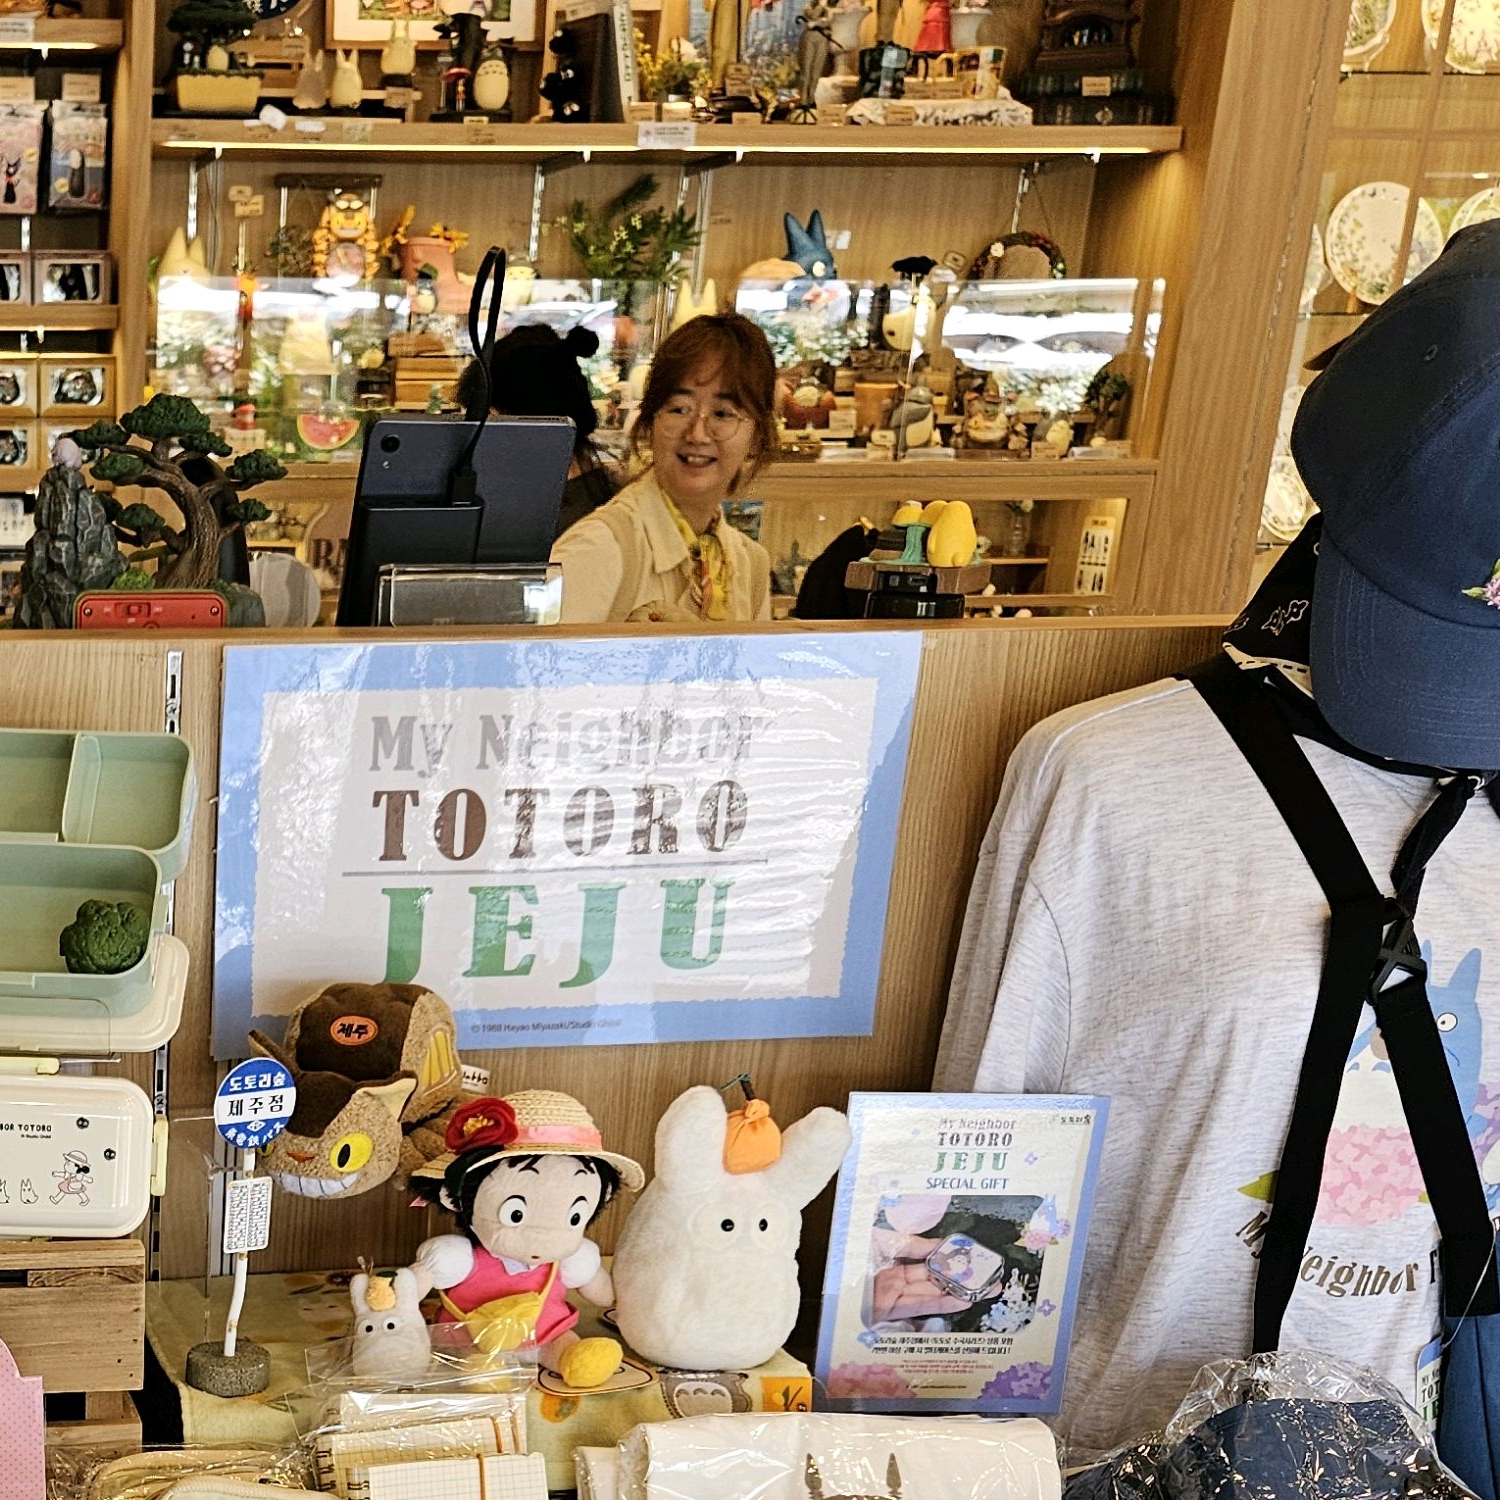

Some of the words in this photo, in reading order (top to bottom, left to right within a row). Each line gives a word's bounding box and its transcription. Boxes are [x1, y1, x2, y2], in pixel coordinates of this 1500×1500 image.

[369, 714, 454, 779] My
[476, 709, 771, 774] Neighbor
[372, 779, 750, 862] TOTORO
[379, 878, 737, 988] JEJU
[336, 1021, 370, 1039] 제주
[229, 1071, 286, 1092] 도토리숲
[227, 1094, 284, 1117] 제주점
[18, 1124, 52, 1132] TOTORO
[937, 1132, 1013, 1147] TOTORO
[932, 1152, 1008, 1173] JEJU
[926, 1177, 977, 1190] SPECIAL
[980, 1177, 1010, 1190] GIFT
[1300, 1246, 1418, 1297] eighbor
